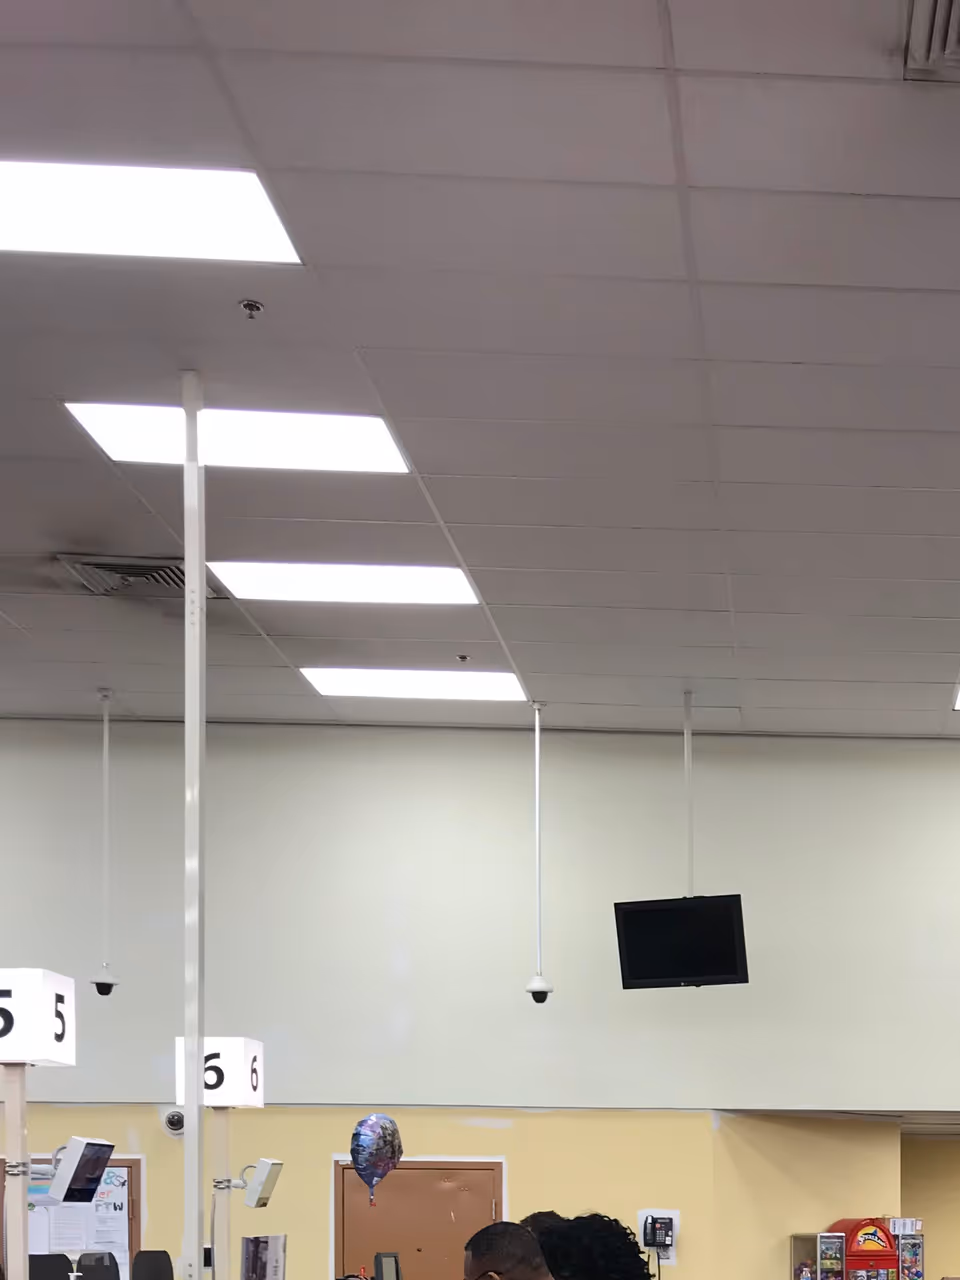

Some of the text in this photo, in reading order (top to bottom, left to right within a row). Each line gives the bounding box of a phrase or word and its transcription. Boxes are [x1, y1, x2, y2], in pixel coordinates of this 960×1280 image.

[54, 993, 66, 1042] 5
[203, 1052, 225, 1090] 6
[250, 1055, 259, 1093] 6
